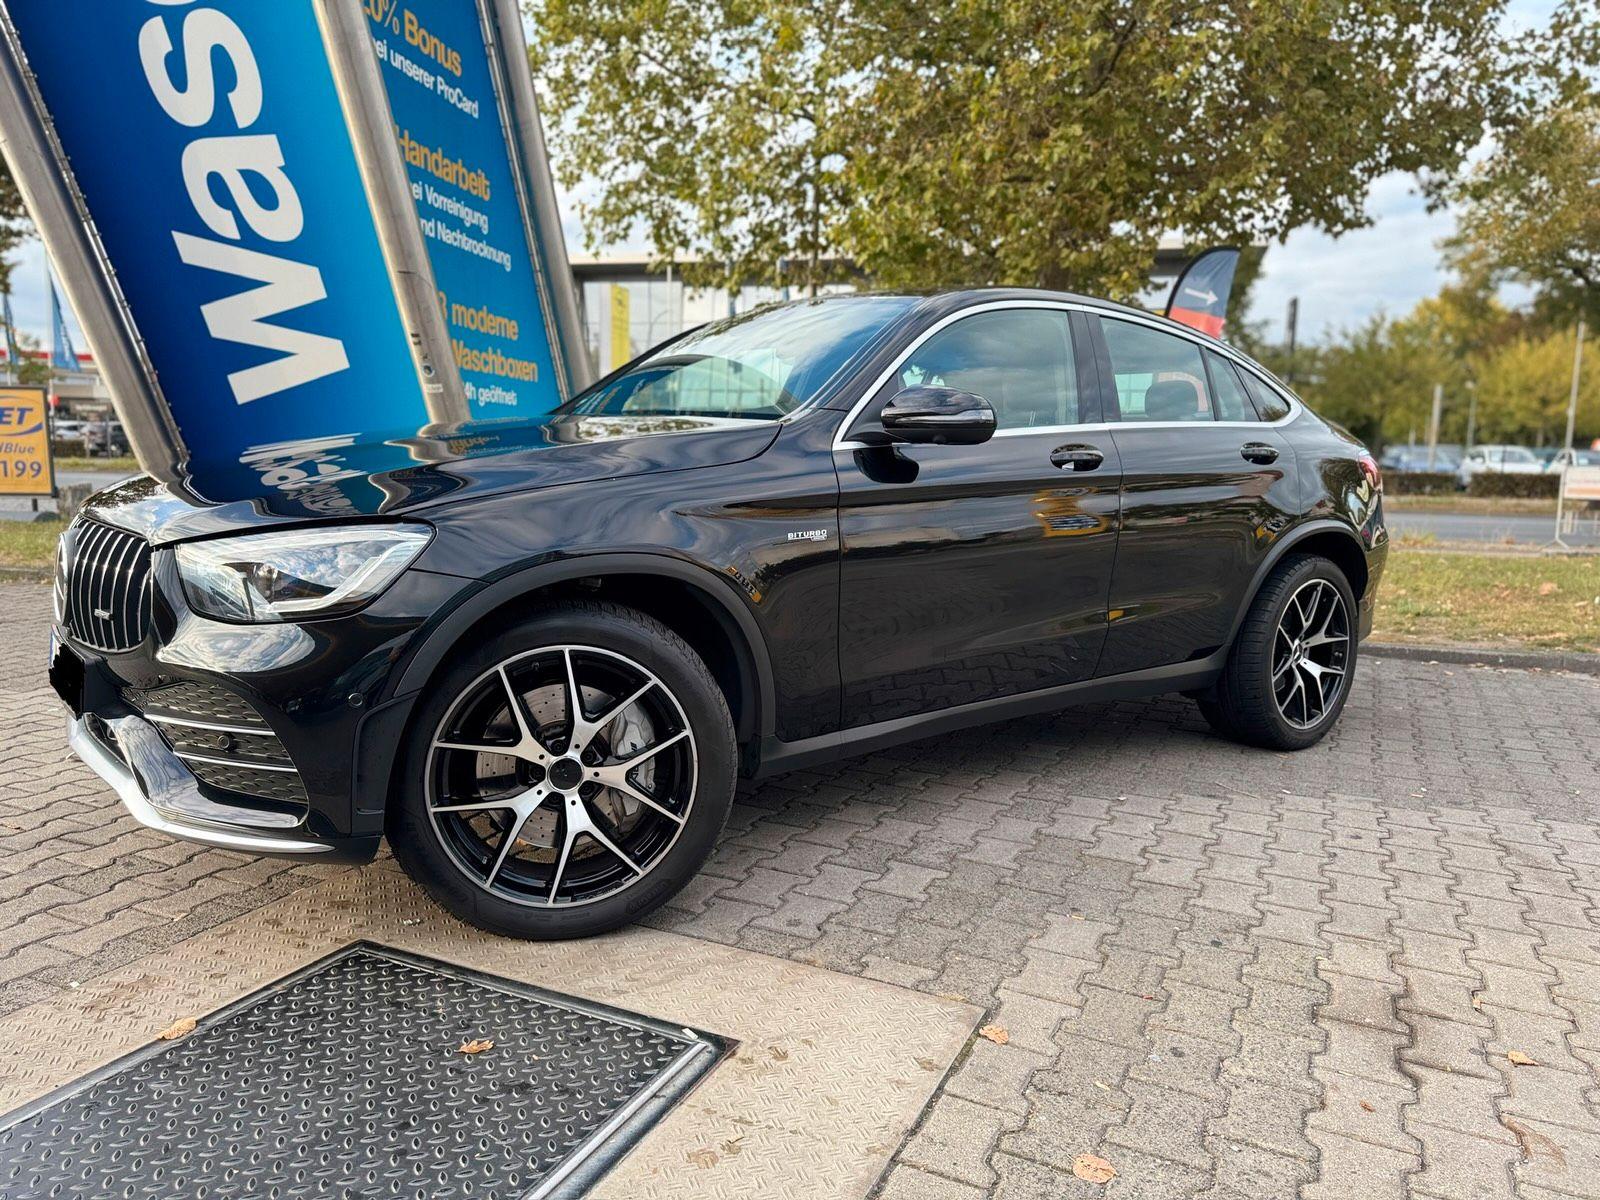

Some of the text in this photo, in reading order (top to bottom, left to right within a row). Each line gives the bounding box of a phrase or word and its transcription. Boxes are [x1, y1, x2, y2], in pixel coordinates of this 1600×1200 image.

[362, 0, 462, 77] 0% Bonus
[372, 37, 479, 120] ei unserer ProCard
[138, 0, 351, 406] Was
[410, 181, 489, 235] ei Vorreinigung
[420, 218, 512, 272] nd Nachtrocknung
[452, 303, 519, 340] moderne
[0, 406, 34, 426] ET
[463, 381, 477, 400] 4h
[478, 385, 517, 407] geöffnet
